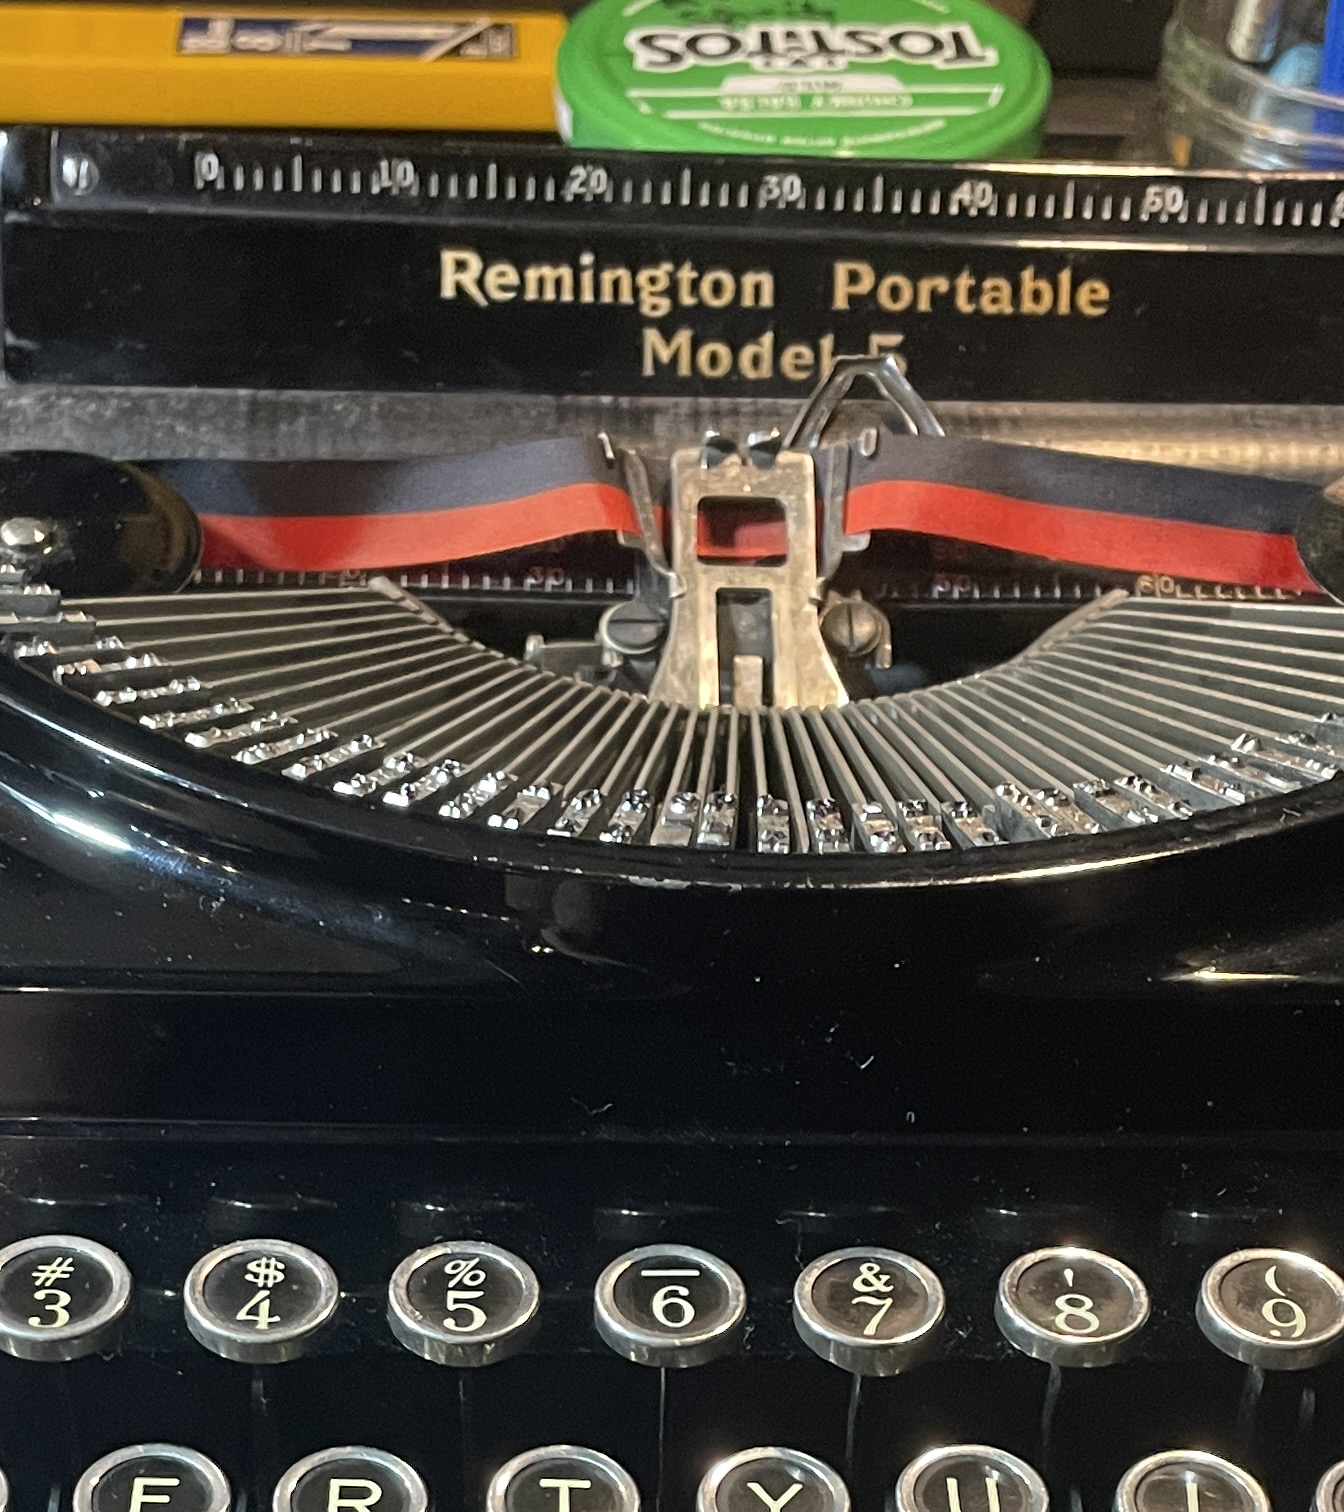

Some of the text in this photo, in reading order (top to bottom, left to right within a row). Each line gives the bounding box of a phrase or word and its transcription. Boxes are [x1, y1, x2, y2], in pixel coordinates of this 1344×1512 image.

[201, 154, 219, 183] 0
[379, 159, 414, 187] 10
[570, 166, 607, 194] 20
[761, 174, 802, 203] 30
[955, 181, 993, 209] 40
[1144, 188, 1183, 214] 50
[441, 248, 1111, 317] Remington Portable
[641, 325, 907, 381] Model 5
[32, 1257, 74, 1286] #
[245, 1257, 284, 1287] $
[445, 1258, 485, 1287] %
[853, 1263, 893, 1292] &
[29, 1290, 73, 1329] 3
[236, 1290, 280, 1330] 4
[443, 1291, 486, 1331] 5
[653, 1286, 694, 1327] 6
[852, 1296, 892, 1335] 7
[1056, 1294, 1099, 1334] 8
[1262, 1299, 1306, 1337] 9
